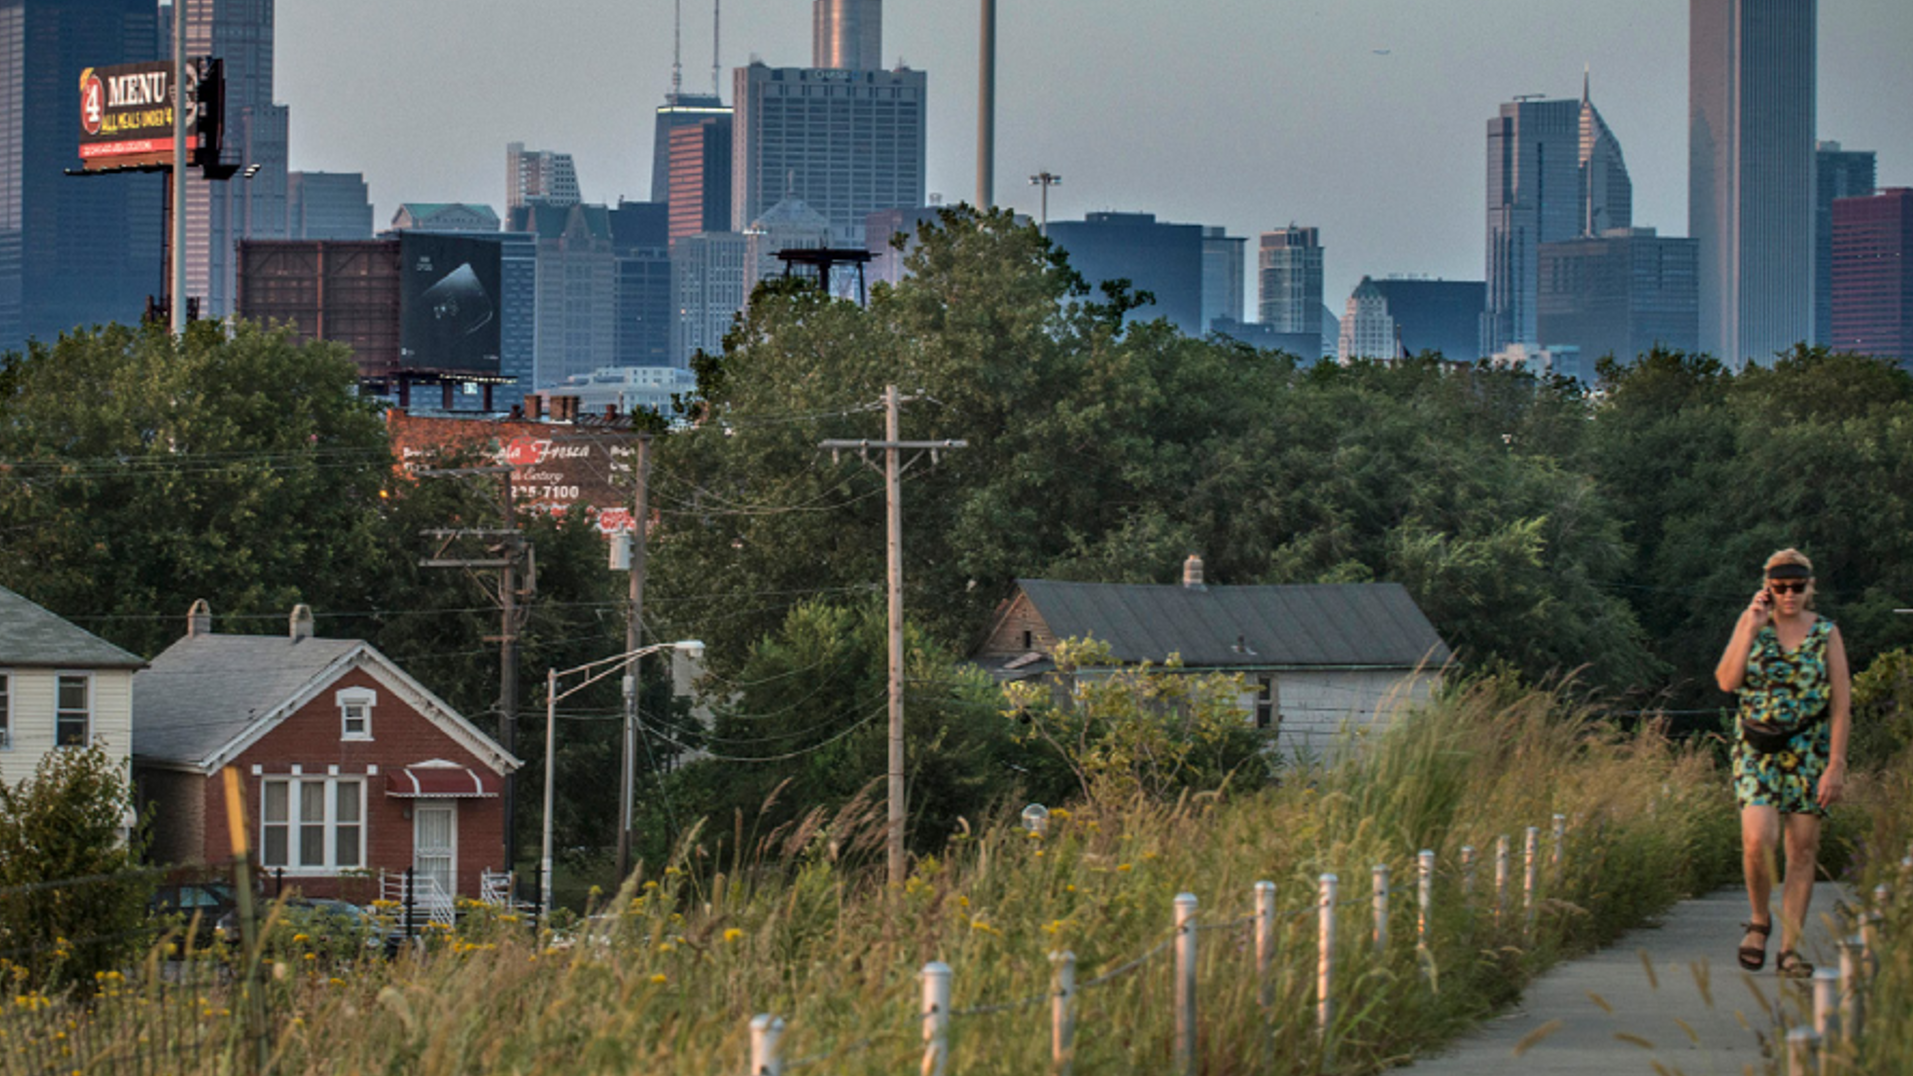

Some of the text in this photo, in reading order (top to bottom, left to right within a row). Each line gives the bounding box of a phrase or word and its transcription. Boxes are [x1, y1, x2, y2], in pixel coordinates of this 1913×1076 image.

[108, 72, 167, 107] MENU
[101, 113, 118, 131] ALL
[118, 111, 140, 129] MEALS
[141, 109, 165, 127] UNDER
[531, 439, 590, 464] Fresca
